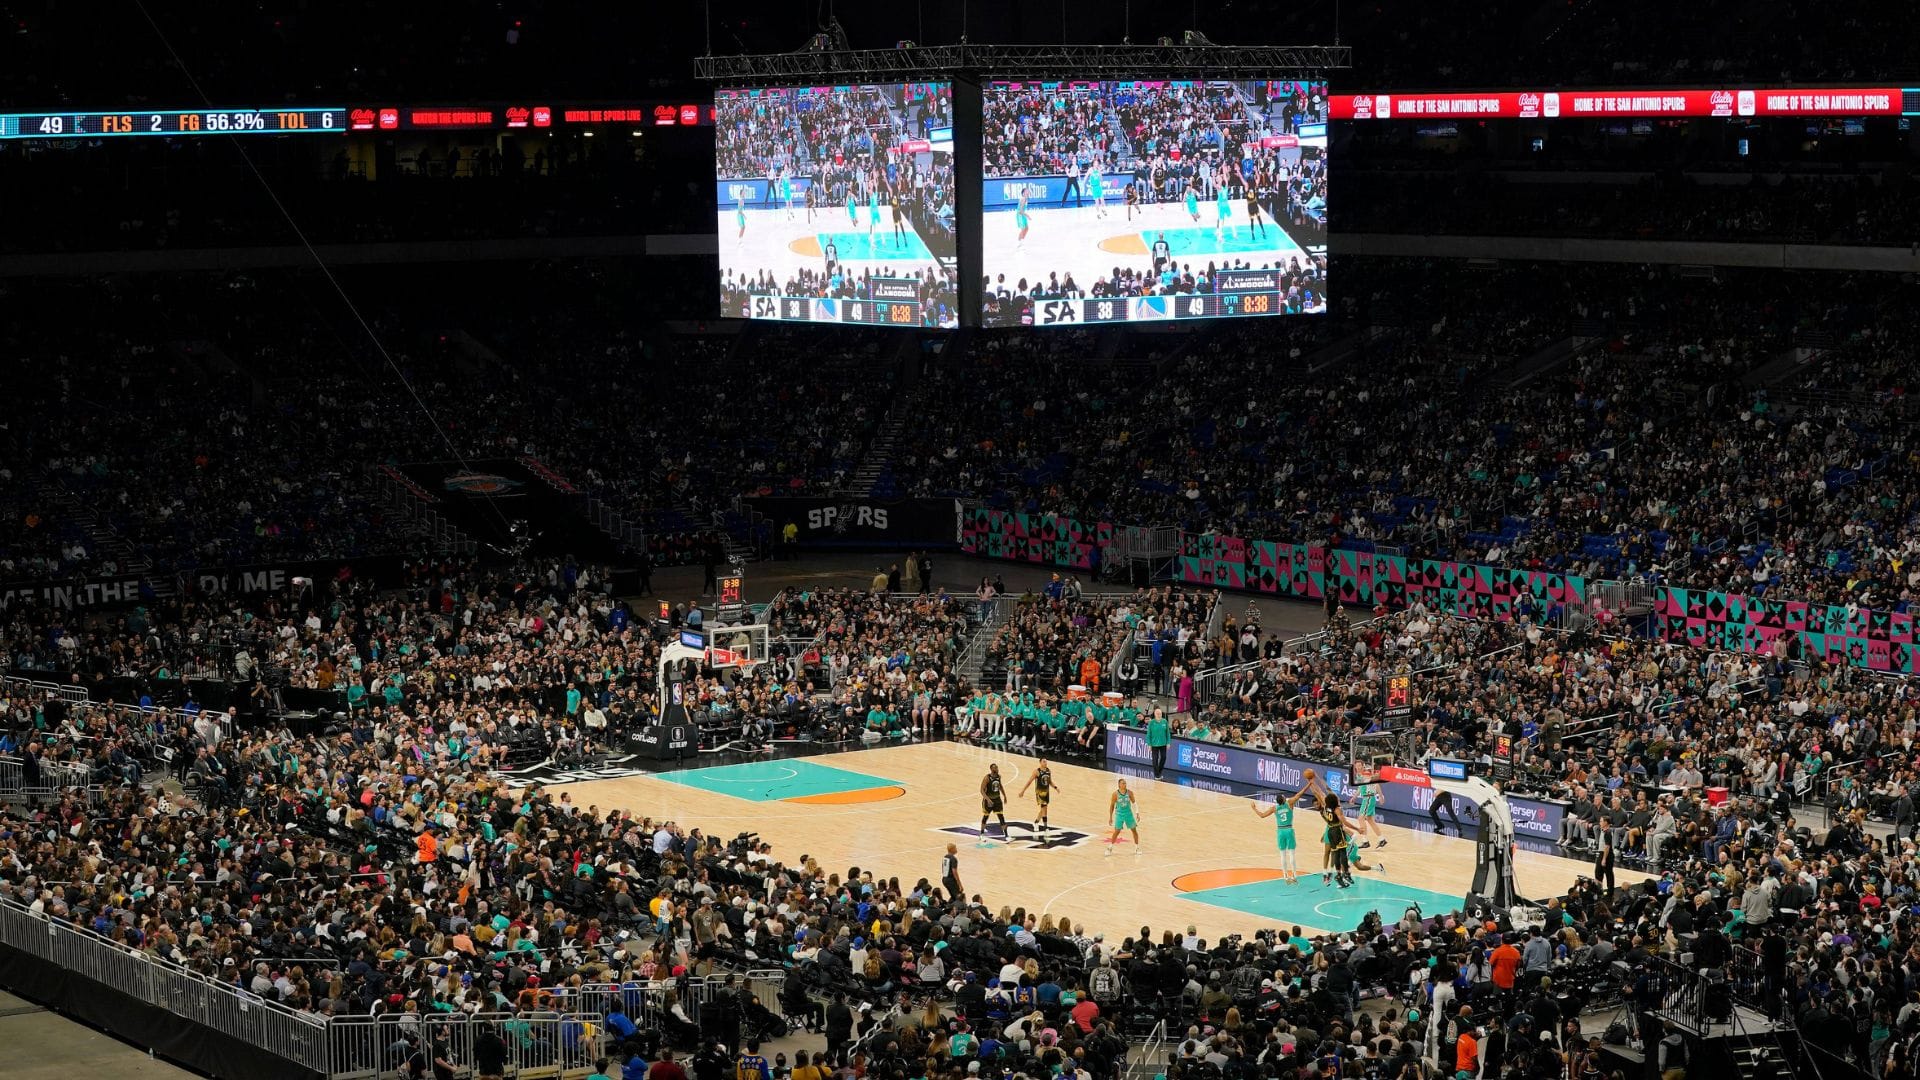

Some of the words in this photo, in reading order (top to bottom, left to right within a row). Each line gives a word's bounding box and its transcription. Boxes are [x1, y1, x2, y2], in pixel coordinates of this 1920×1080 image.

[1398, 100, 1416, 113] HOME
[1416, 100, 1424, 112] OF
[1425, 100, 1436, 112] THE
[1437, 100, 1450, 112] SAN
[1450, 100, 1478, 112] ANTONIO
[1478, 99, 1500, 112] SPURS
[1574, 98, 1594, 111] HOME
[1594, 98, 1603, 111] OF
[1604, 98, 1616, 111] THE
[1617, 98, 1631, 110] SAN
[1632, 97, 1661, 110] ANTONIO
[1662, 96, 1686, 110] SPURS
[1768, 96, 1789, 110] HOME
[1790, 96, 1799, 110] OF
[1800, 96, 1813, 110] THE
[1814, 96, 1830, 110] SAN
[1831, 96, 1863, 110] ANTONIO
[1864, 95, 1890, 110] SPURS
[40, 117, 63, 134] 49
[102, 116, 132, 132] FLS
[151, 115, 162, 131] 2
[179, 114, 200, 131] FG
[206, 113, 264, 130] 56.3%
[278, 113, 308, 129] TOL
[322, 112, 333, 129] 6
[1222, 274, 1275, 288] ALAMODOME
[756, 297, 776, 317] SA
[1188, 298, 1204, 316] 49
[1224, 296, 1238, 305] QTR
[1244, 296, 1268, 312] 8:38
[789, 300, 800, 318] 38
[851, 303, 862, 320] 49
[892, 305, 911, 322] 8:38
[1044, 301, 1076, 324] SA
[1098, 302, 1113, 320] 38
[1228, 306, 1234, 314] 2
[724, 579, 740, 588] 8:38
[84, 580, 140, 605] THE
[722, 588, 738, 602] 24
[1392, 678, 1408, 688] 8:38
[1388, 688, 1406, 706] 24
[1122, 734, 1136, 756] NBA
[1193, 747, 1219, 762] Jersey
[1192, 760, 1232, 774] Assurance
[1264, 760, 1280, 782] NBA
[1281, 764, 1300, 787] Store
[1280, 813, 1287, 822] 3
[1511, 817, 1552, 833] ssurance
[1648, 928, 1658, 940] 30
[1096, 980, 1110, 992] 21
[1018, 994, 1029, 1002] 30
